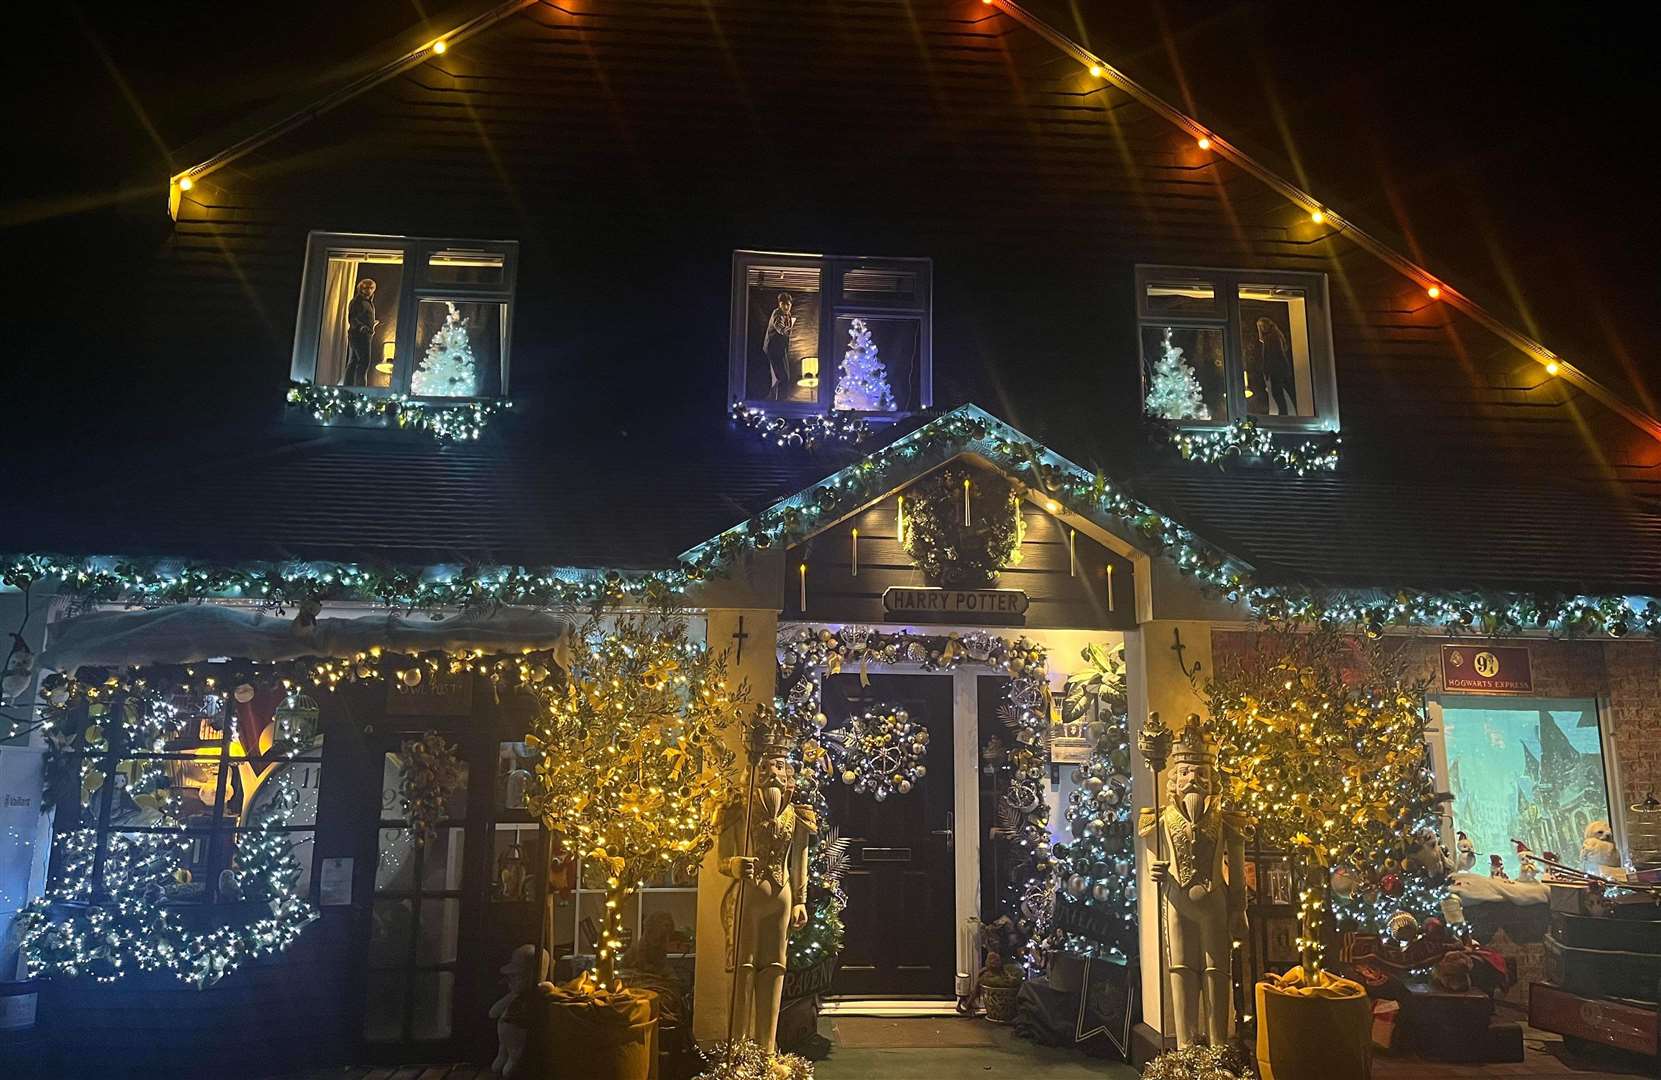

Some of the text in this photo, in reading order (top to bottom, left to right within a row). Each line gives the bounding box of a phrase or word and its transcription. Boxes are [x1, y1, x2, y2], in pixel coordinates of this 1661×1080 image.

[894, 591, 1019, 611] HARRY POTTER
[1448, 679, 1529, 688] HOGWARTS EXPRESS
